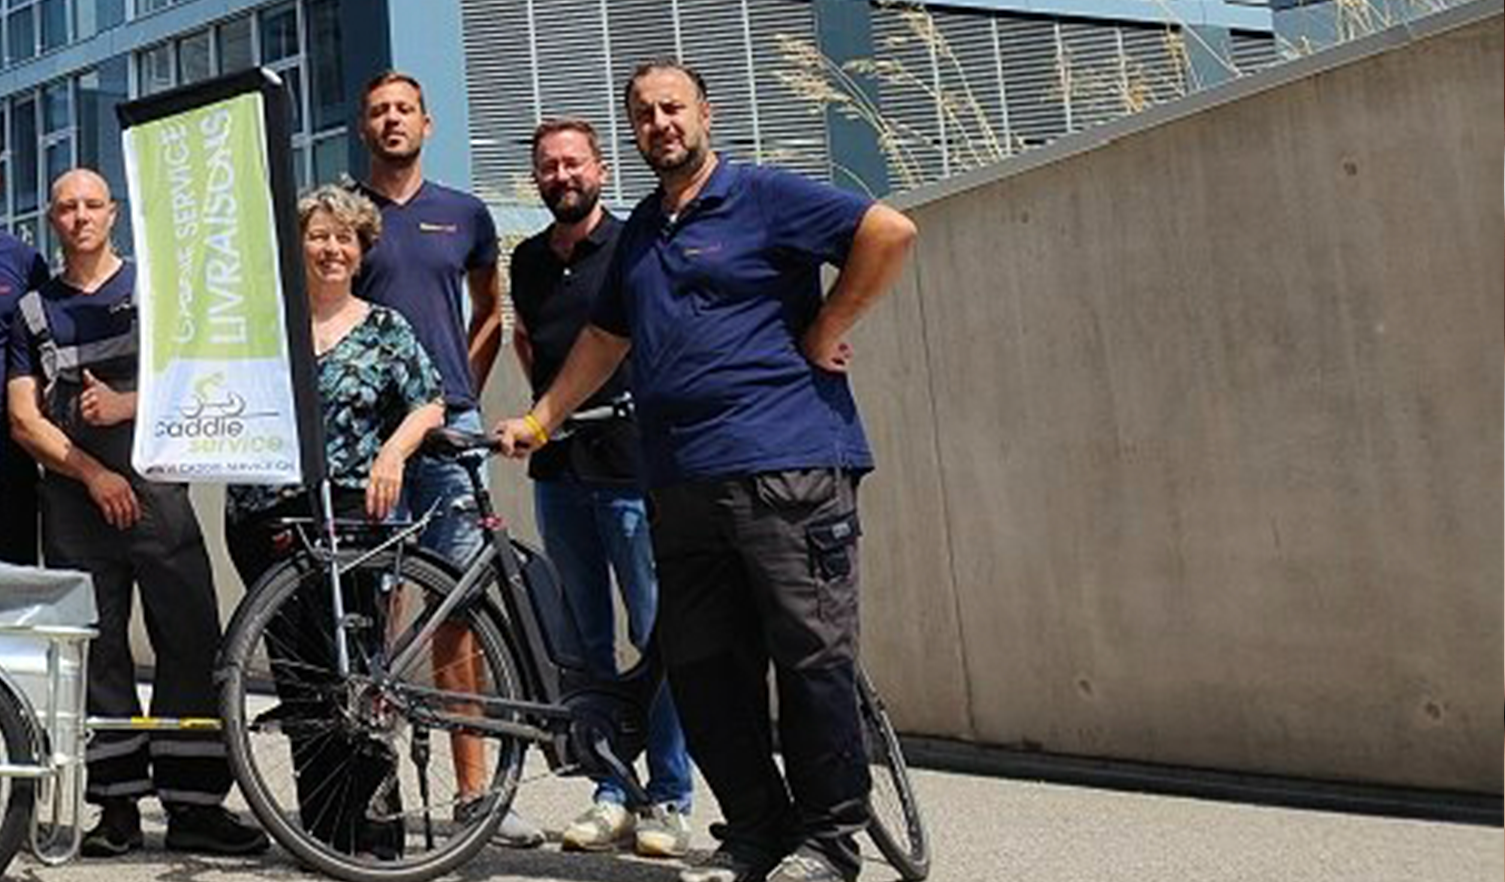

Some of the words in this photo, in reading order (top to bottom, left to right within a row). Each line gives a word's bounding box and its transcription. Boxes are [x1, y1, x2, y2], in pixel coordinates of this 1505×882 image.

[159, 122, 198, 238] SERVICE
[200, 108, 247, 344] LIVRAISONS
[154, 417, 244, 438] caddie
